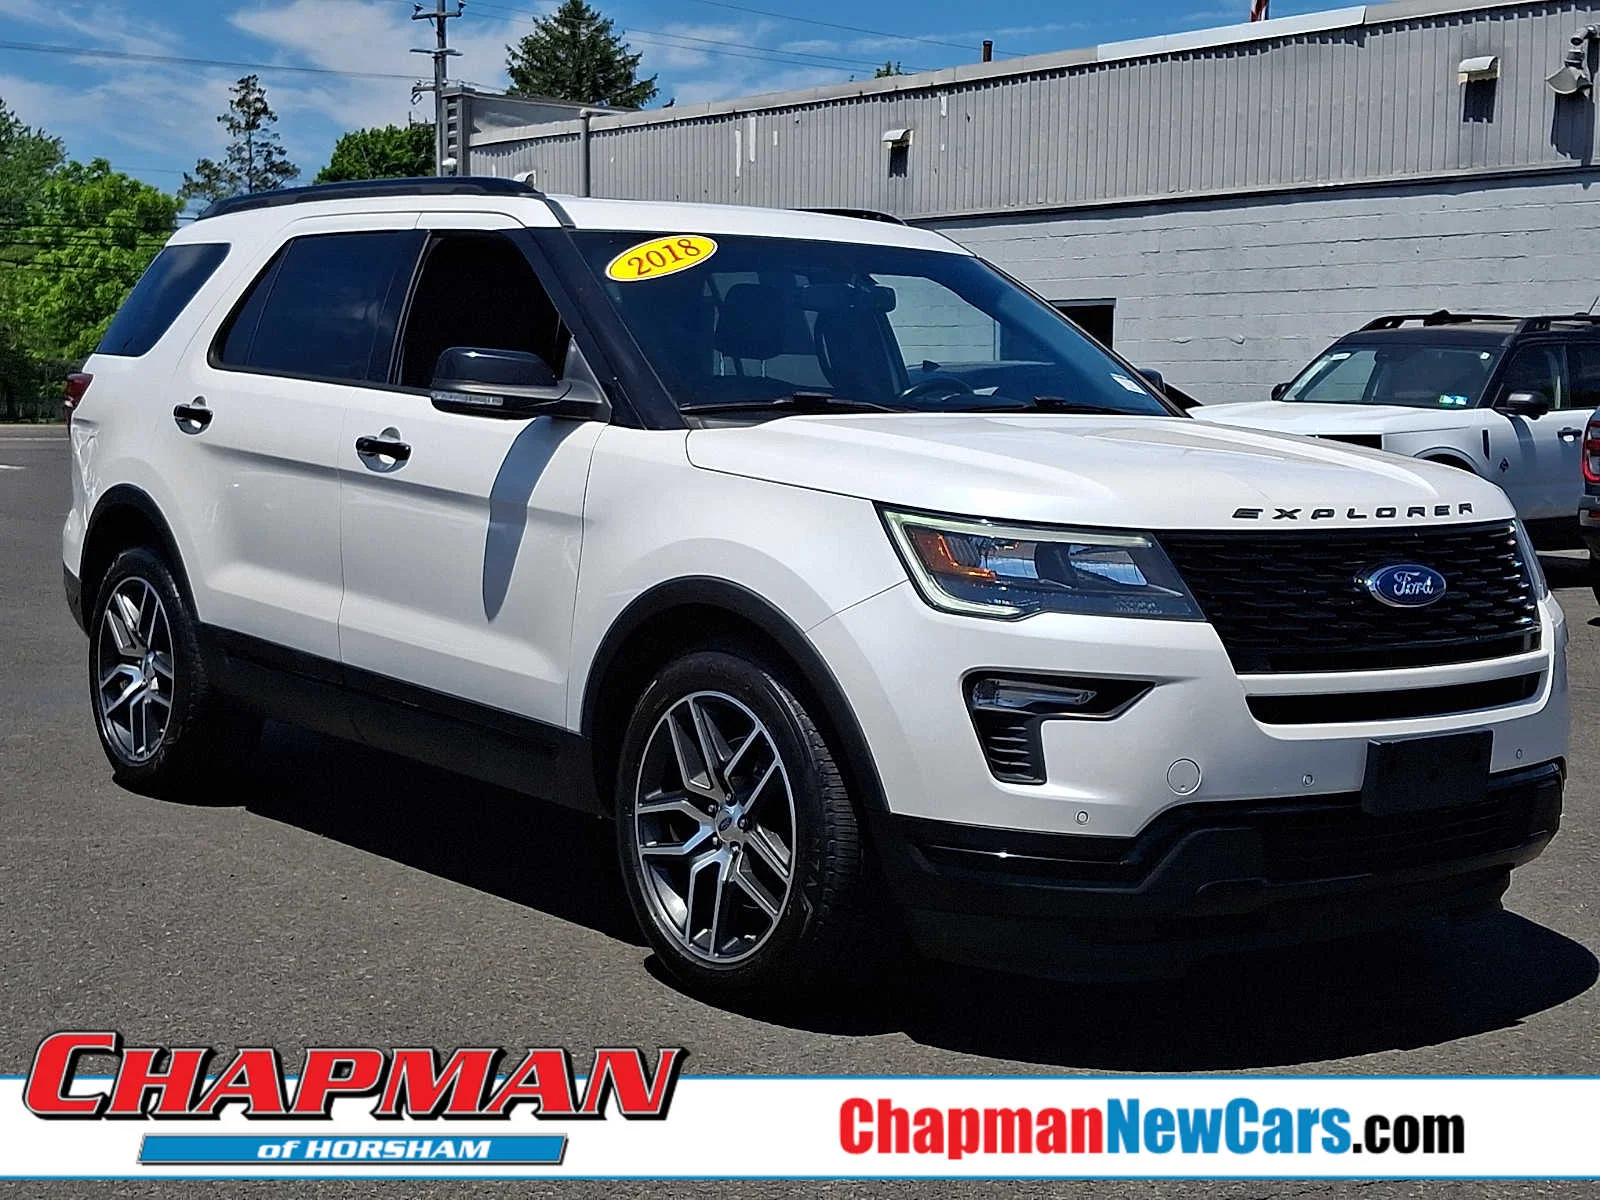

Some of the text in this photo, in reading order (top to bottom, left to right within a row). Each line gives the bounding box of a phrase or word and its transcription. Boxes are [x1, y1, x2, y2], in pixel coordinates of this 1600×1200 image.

[627, 239, 701, 276] 2018
[1232, 502, 1474, 520] EXPLORER
[1393, 570, 1434, 597] Ford
